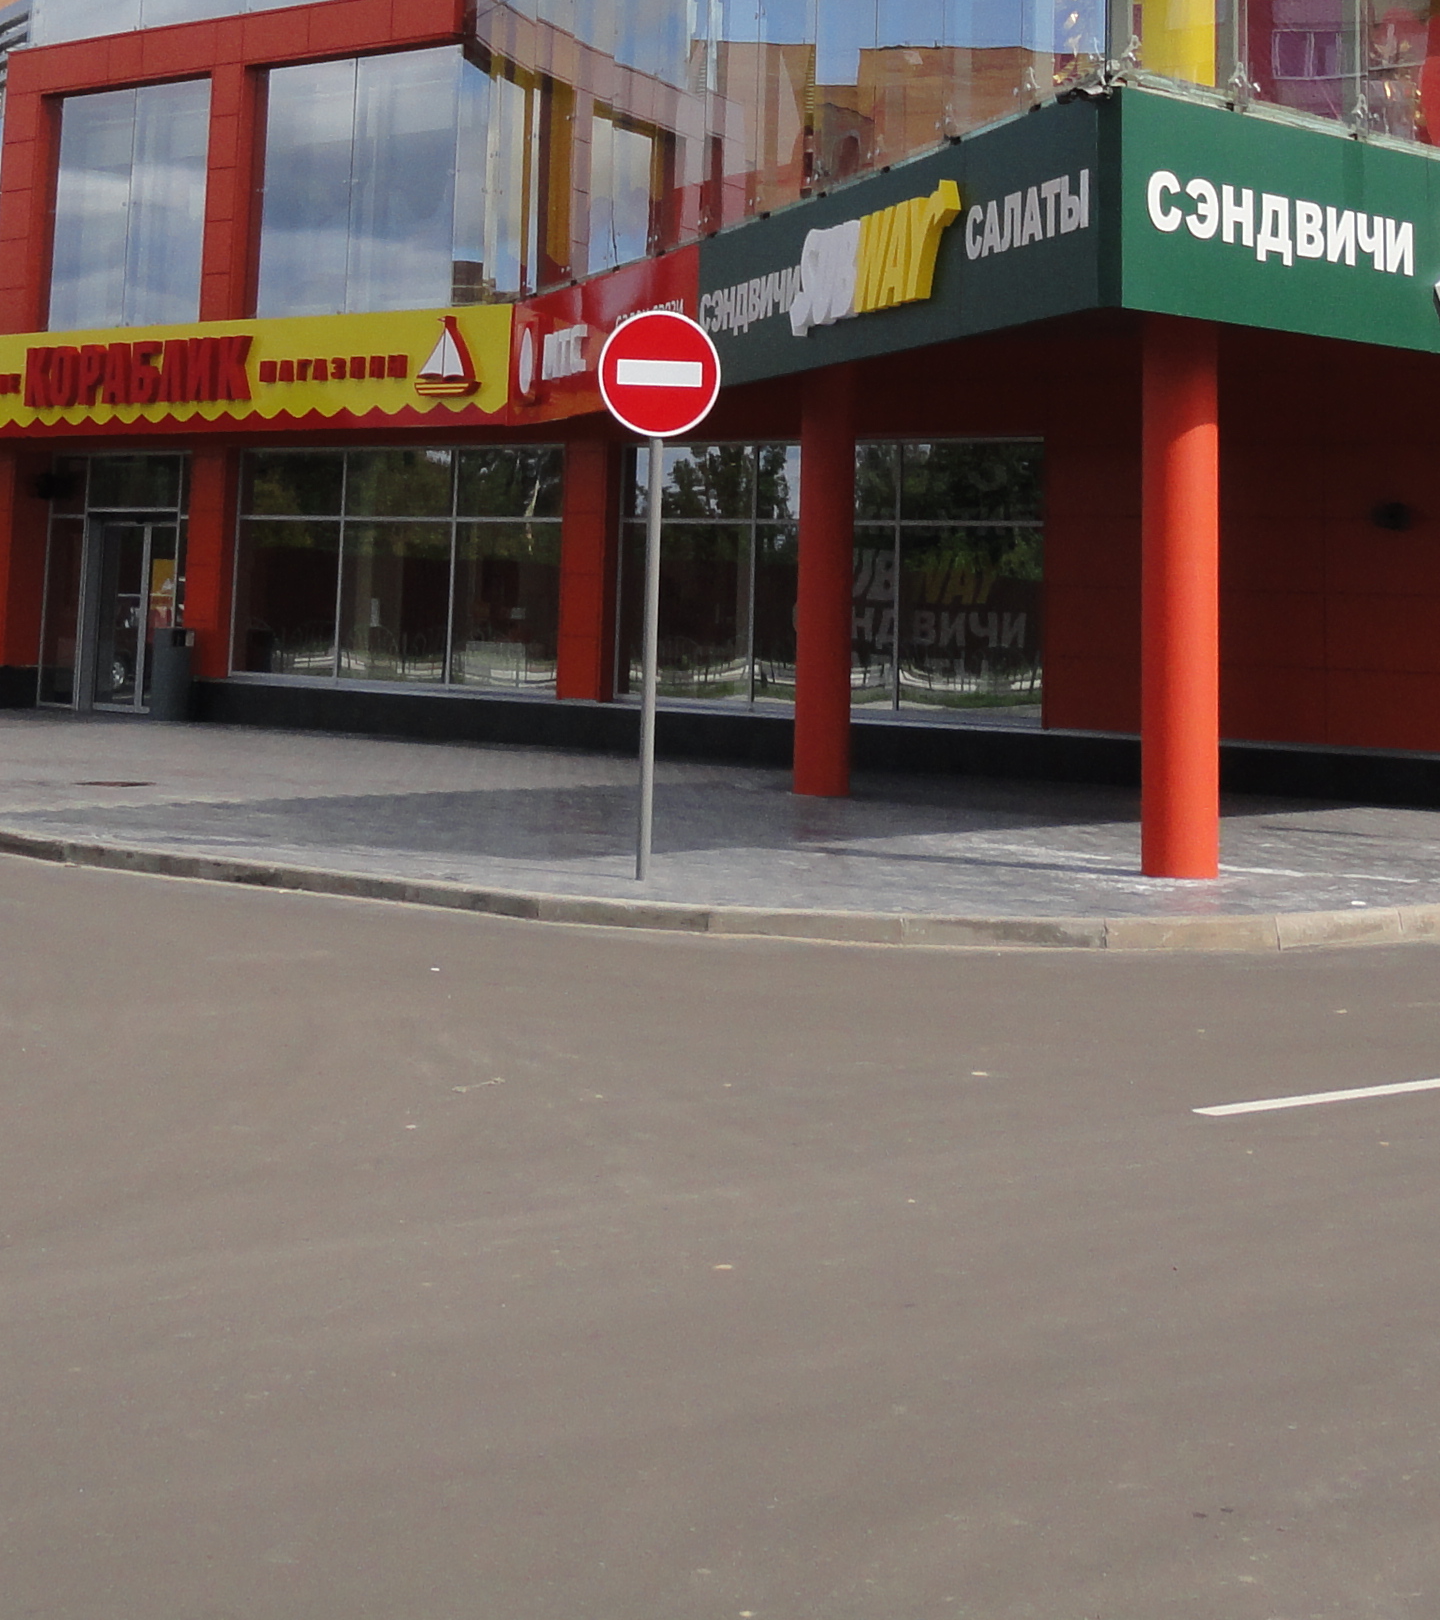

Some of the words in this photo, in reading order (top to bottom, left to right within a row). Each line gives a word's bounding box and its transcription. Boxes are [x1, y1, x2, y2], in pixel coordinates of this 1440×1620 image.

[699, 265, 804, 336] СЭНДВИЧИ
[789, 179, 962, 337] SUBWAY
[965, 168, 1091, 261] САЛАТЫ
[1146, 169, 1414, 277] СЭНДВИЧИ
[24, 335, 254, 407] КОРАБЛИК
[541, 324, 588, 381] МТС
